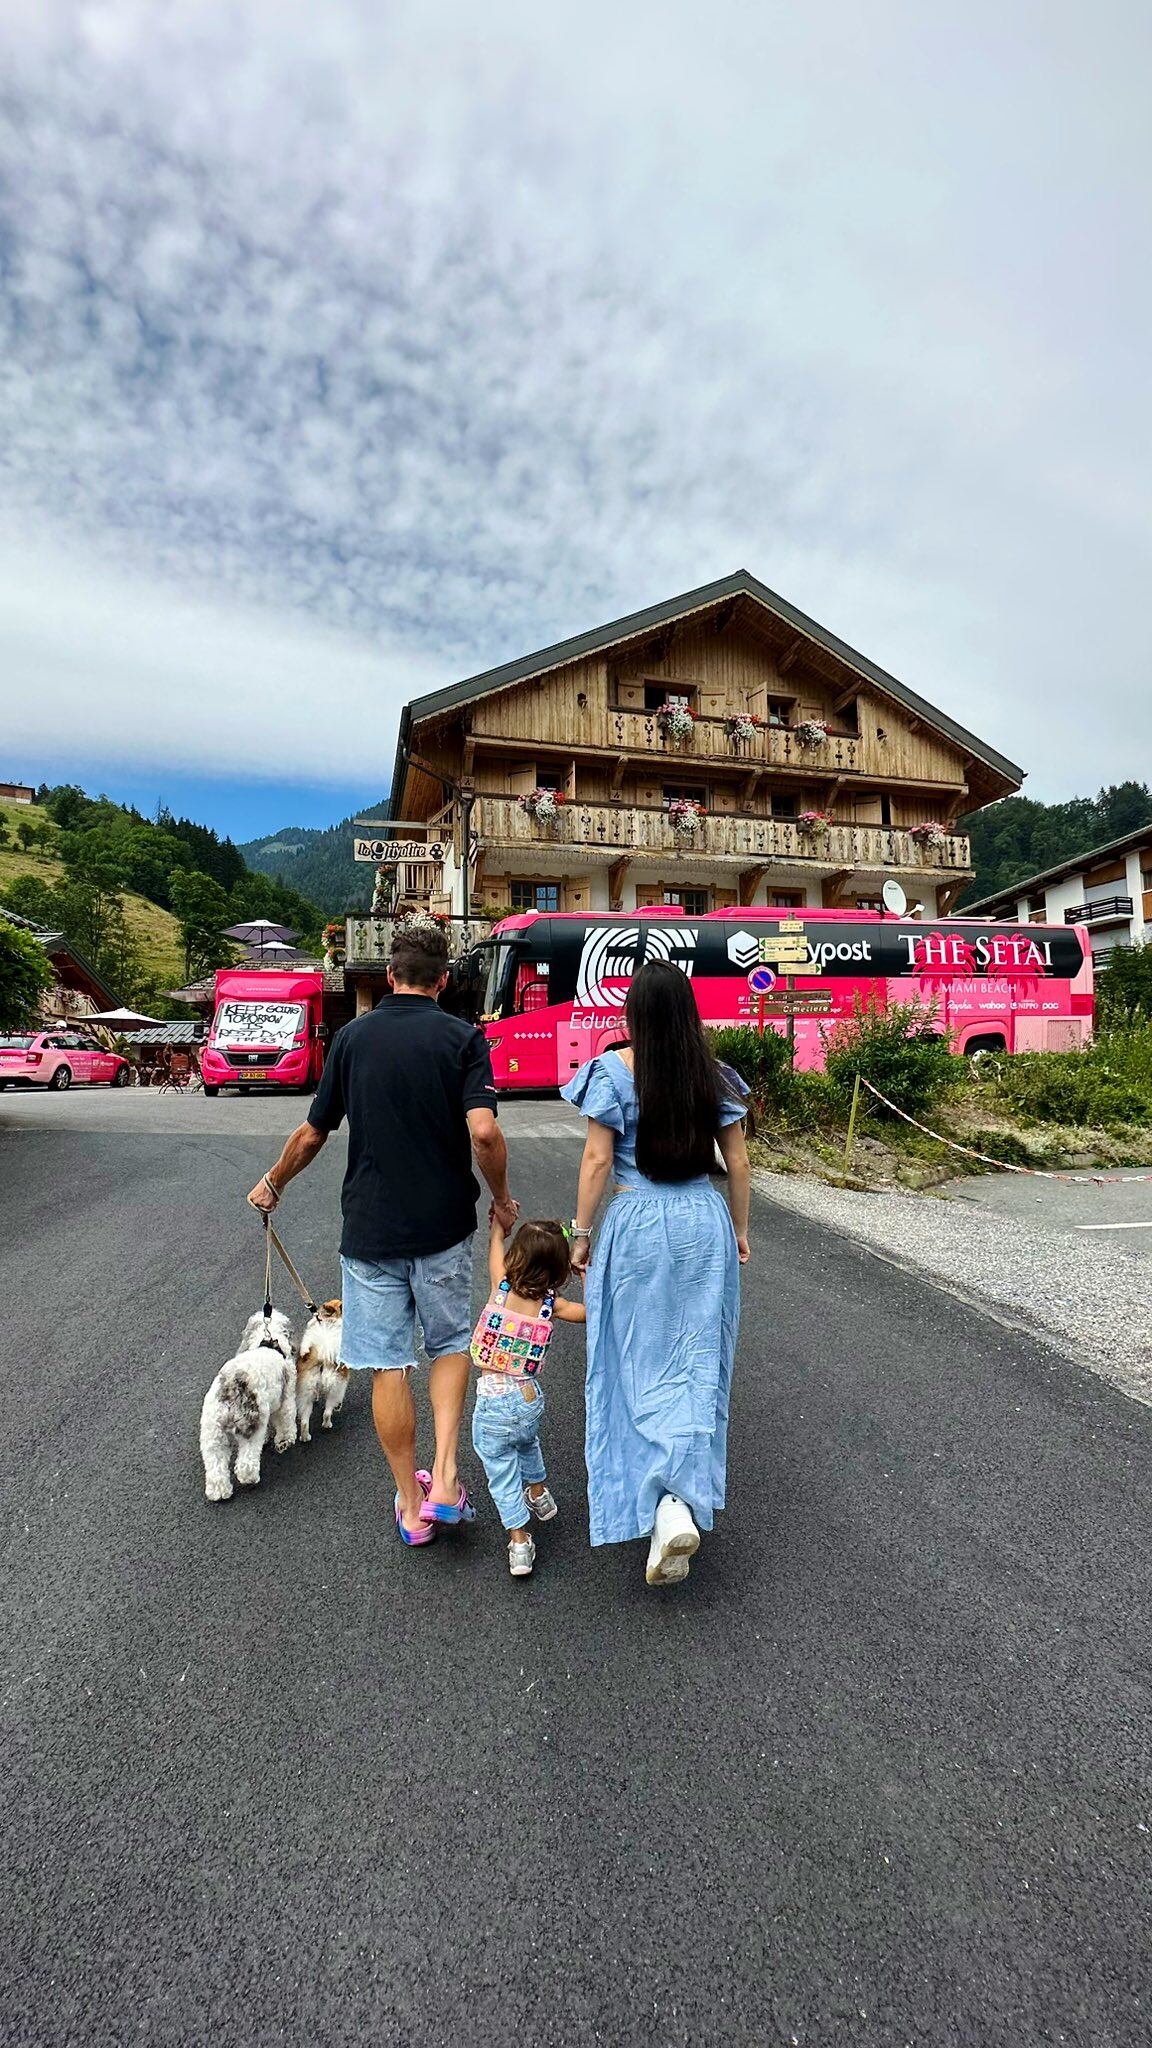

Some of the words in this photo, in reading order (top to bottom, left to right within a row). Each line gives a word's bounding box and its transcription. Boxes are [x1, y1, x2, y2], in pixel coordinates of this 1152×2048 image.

[898, 934, 966, 966] THE
[975, 936, 1053, 966] SETAI
[941, 983, 977, 993] MIAMI
[981, 983, 1017, 993] BEACH
[225, 1004, 264, 1015] KEEP
[224, 1013, 283, 1023] TOMORROW
[242, 1022, 263, 1030] IS
[218, 1029, 257, 1039] REST
[260, 1030, 294, 1039] DAY
